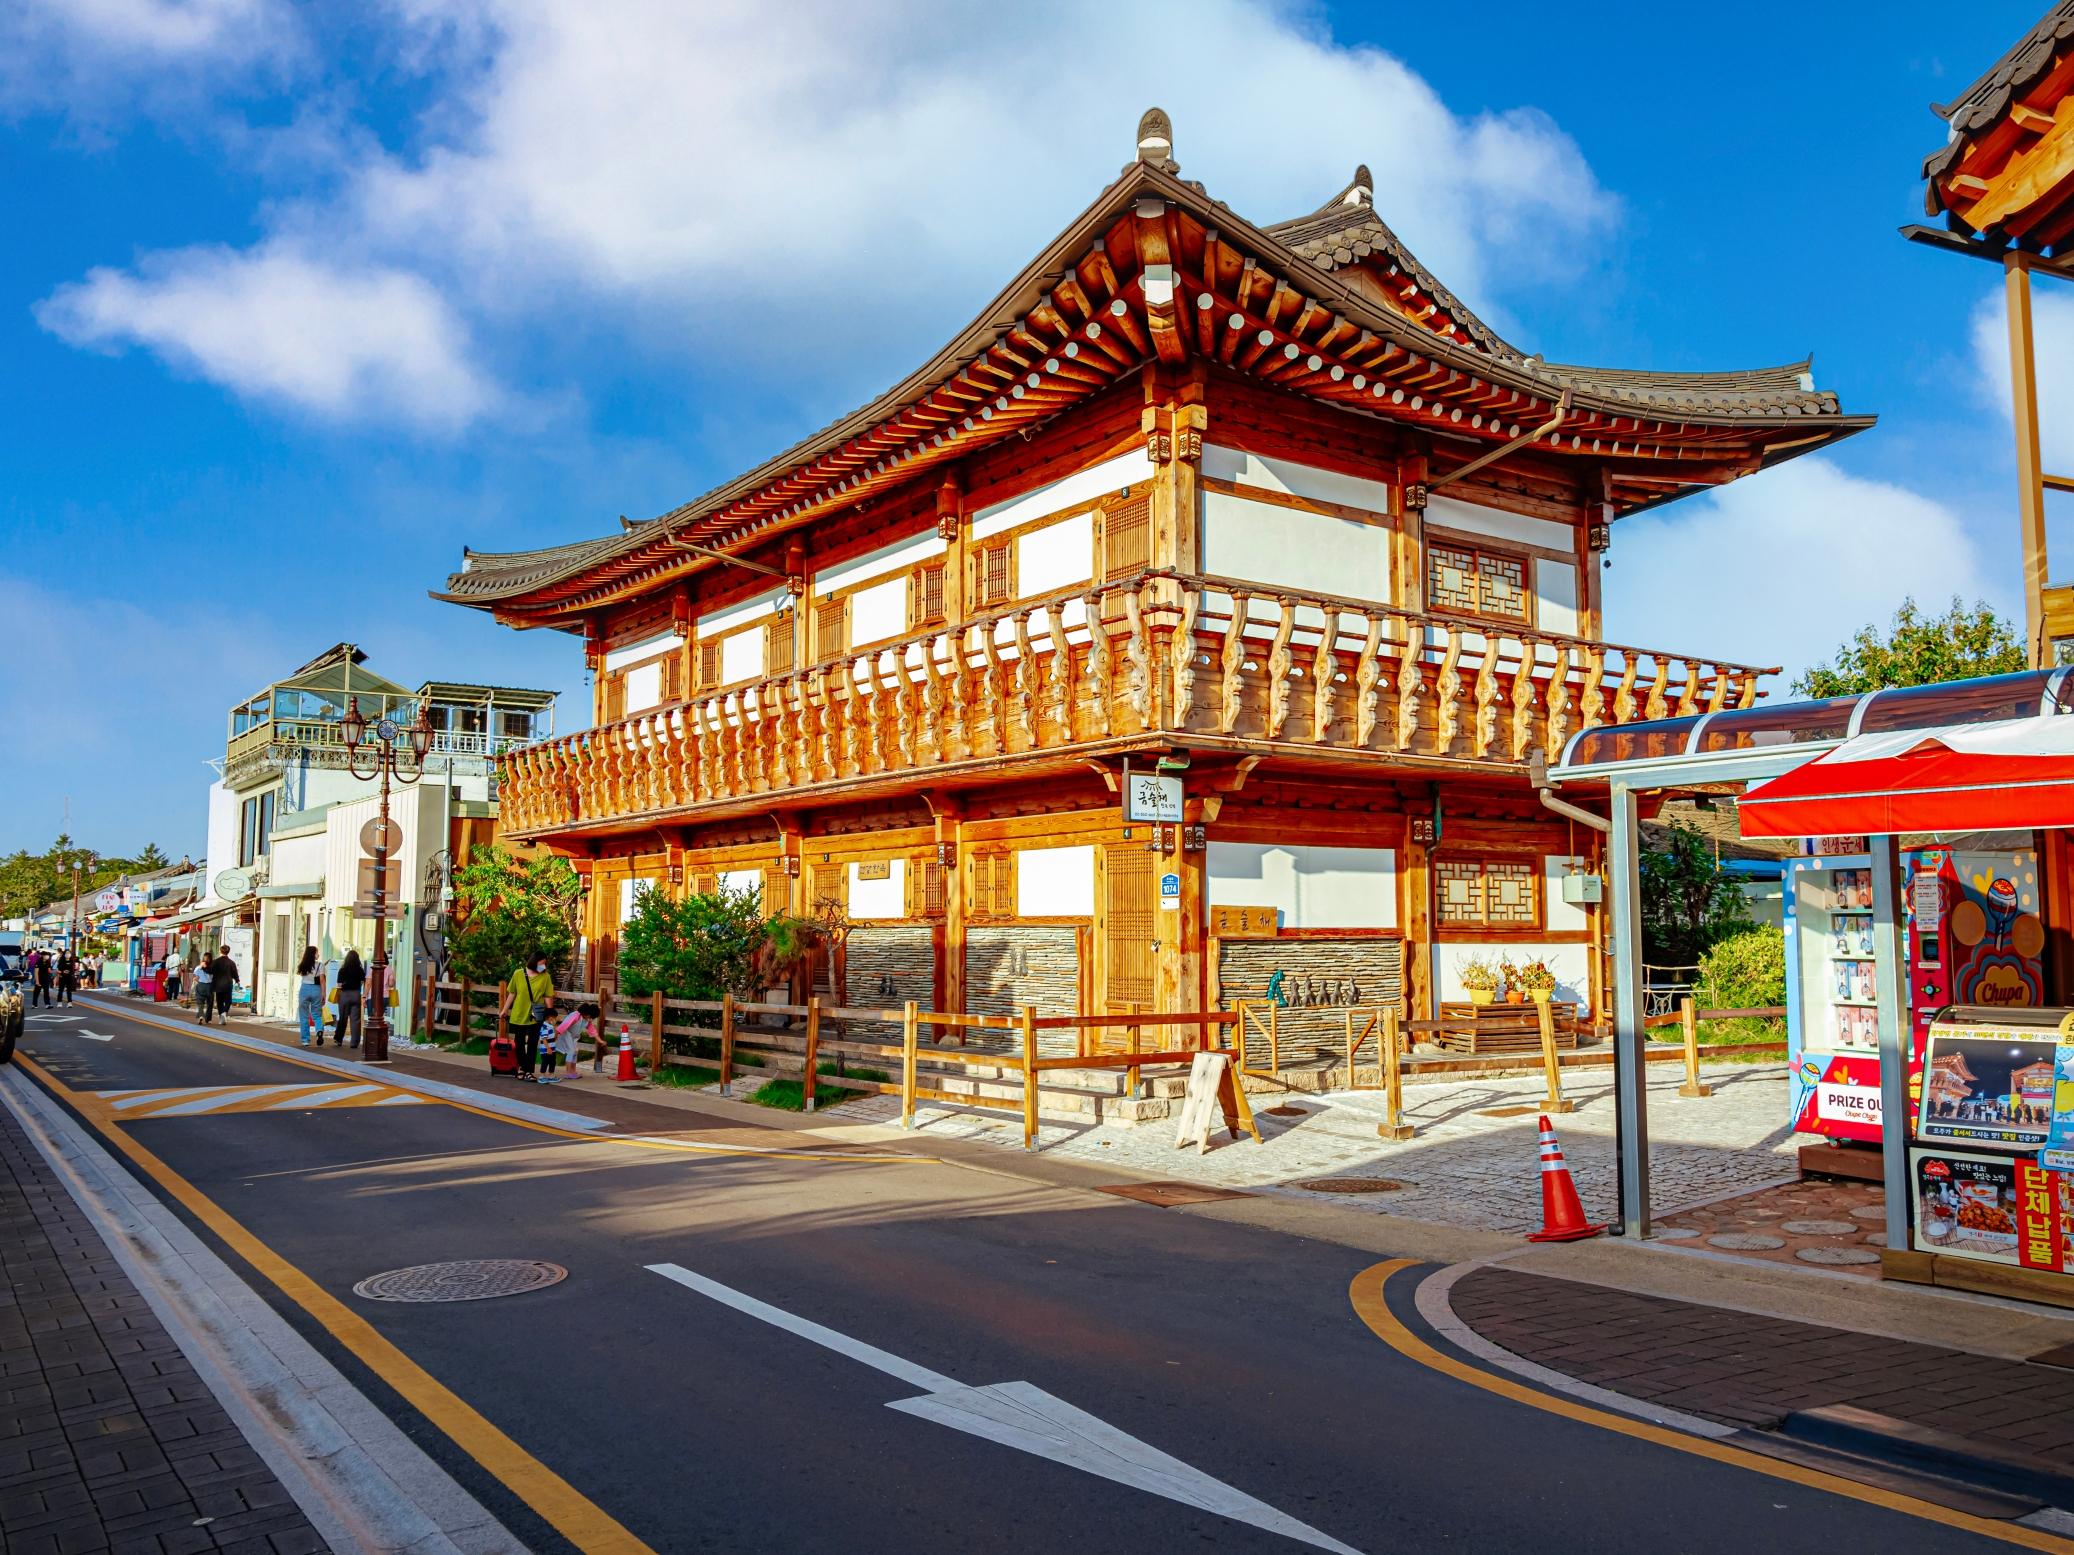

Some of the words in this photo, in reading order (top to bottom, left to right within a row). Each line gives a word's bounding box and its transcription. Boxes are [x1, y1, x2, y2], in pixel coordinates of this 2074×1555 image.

[1822, 836, 1863, 853] 인생운세
[1163, 884, 1177, 894] 1074
[1982, 982, 2024, 1004] Chupa
[1828, 1094, 1864, 1109] PRIZE
[2023, 1165, 2053, 1265] 단체납품
